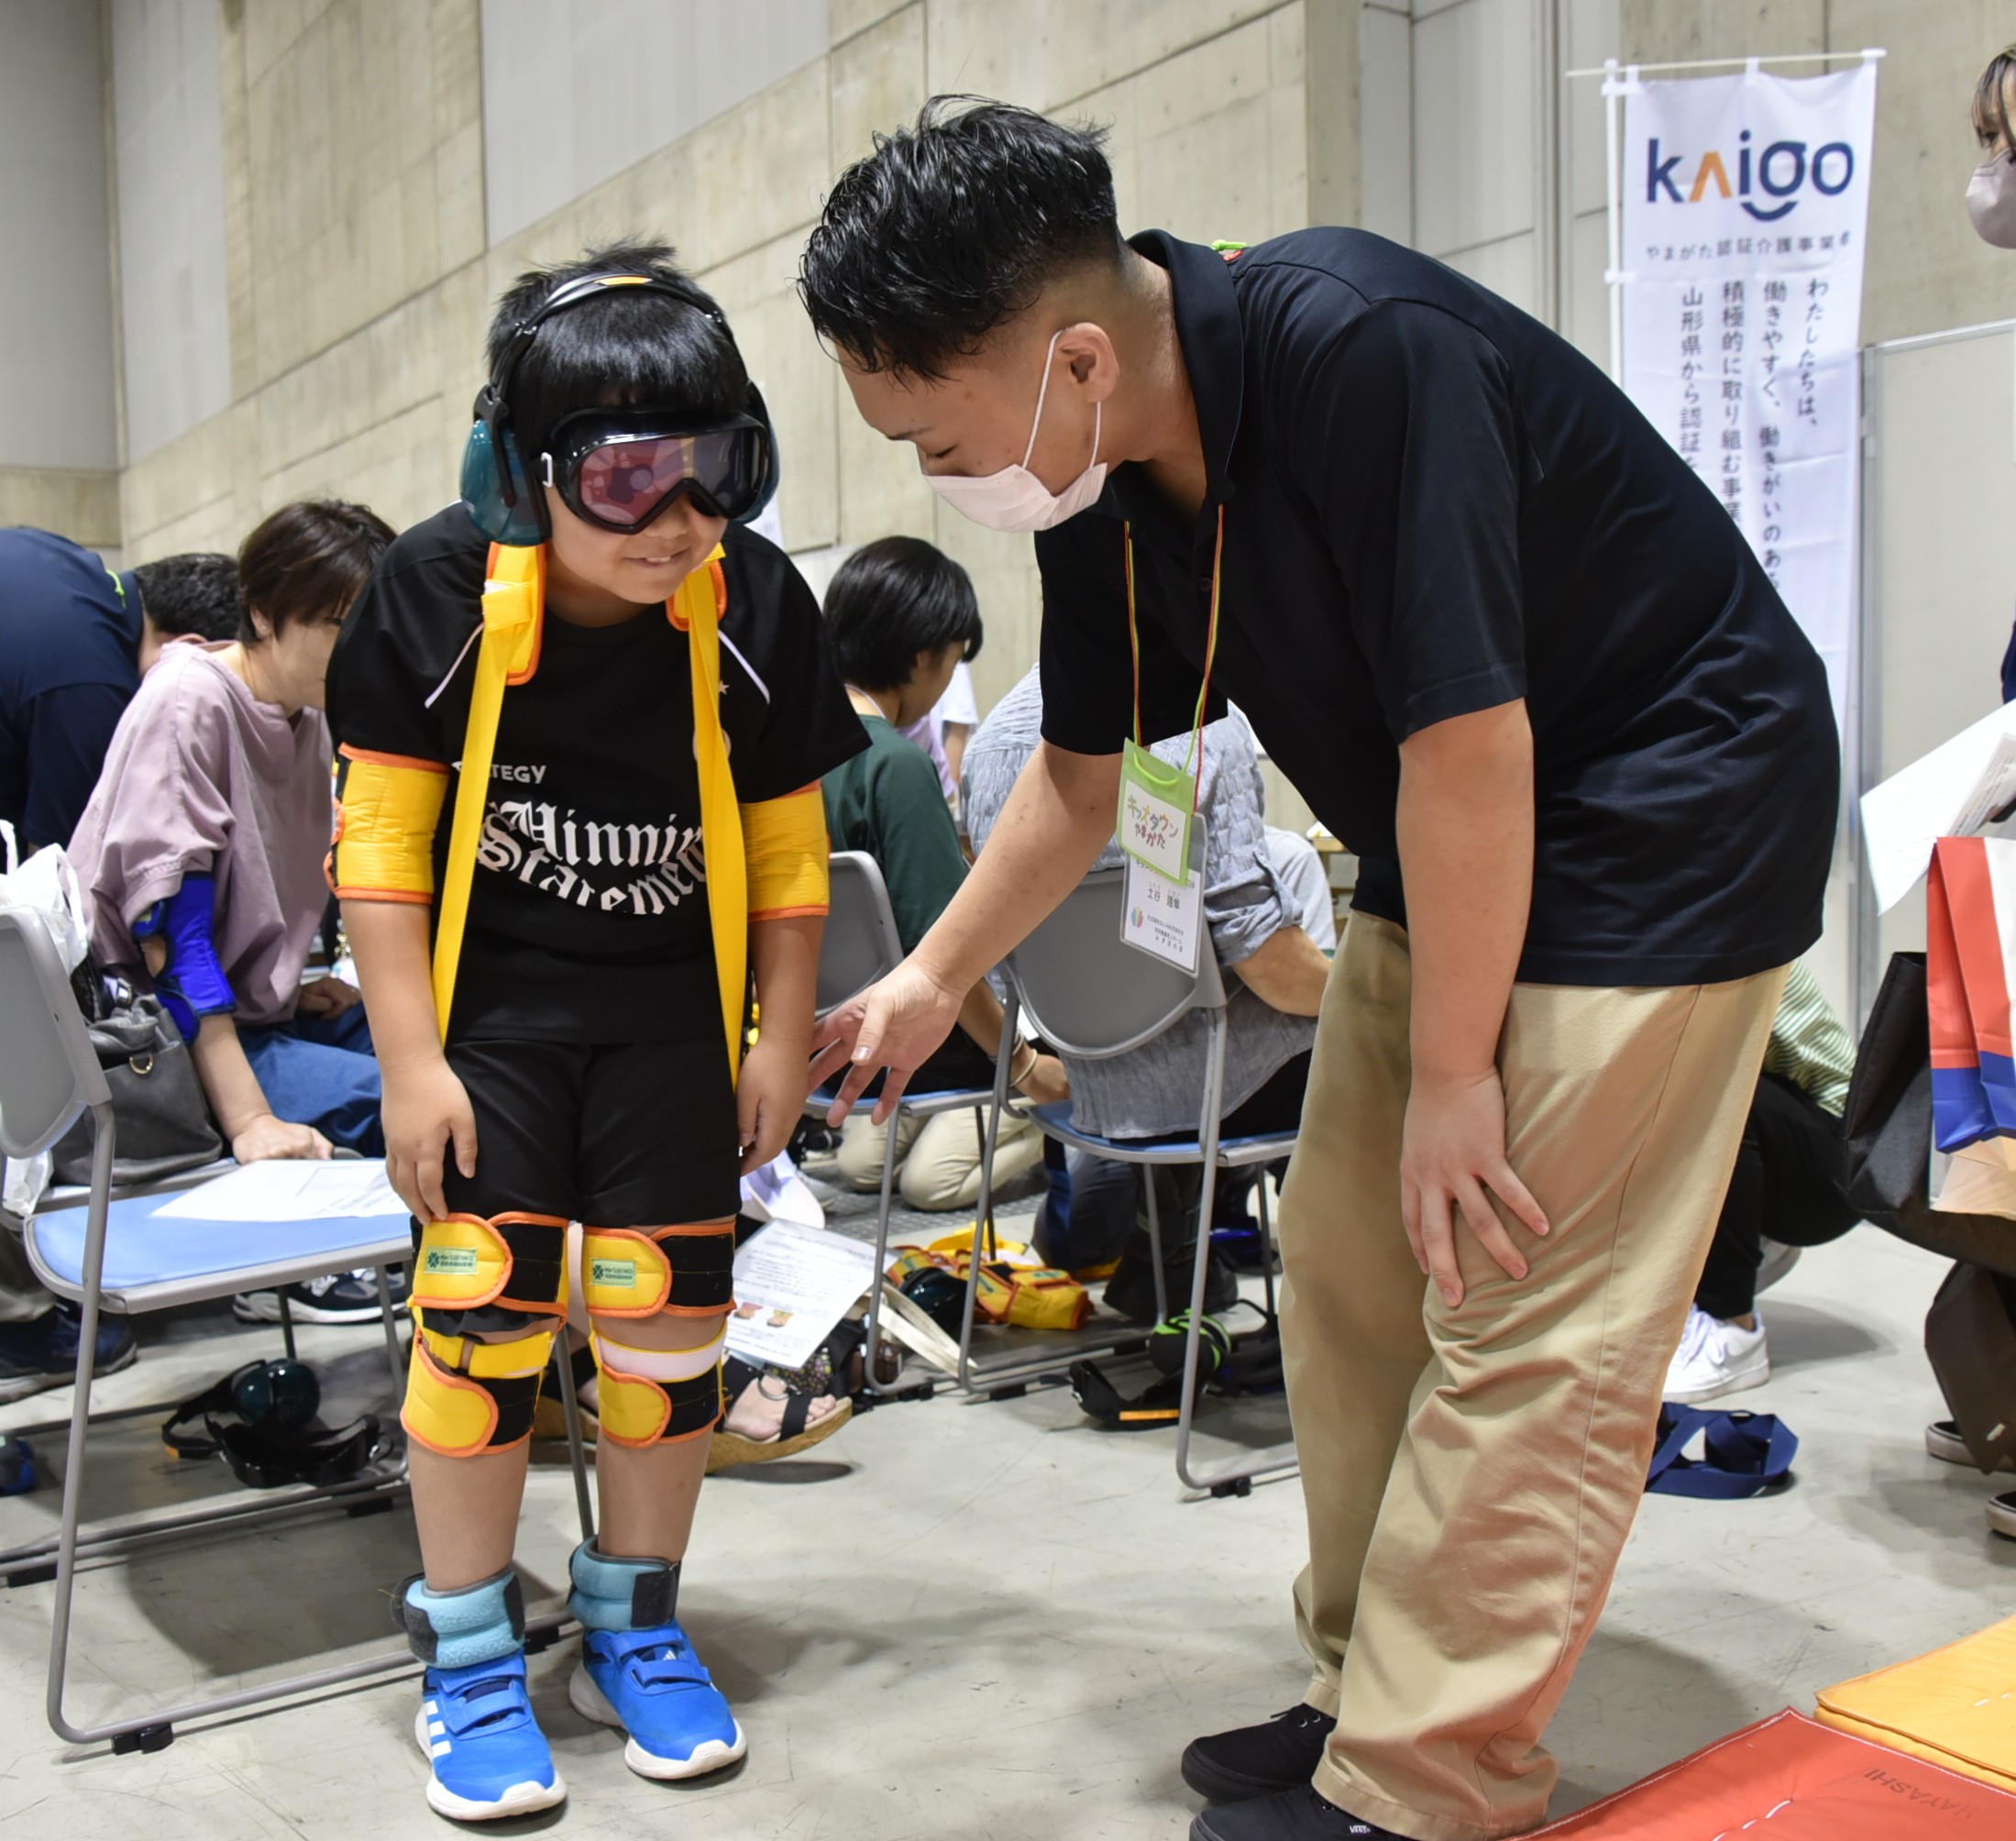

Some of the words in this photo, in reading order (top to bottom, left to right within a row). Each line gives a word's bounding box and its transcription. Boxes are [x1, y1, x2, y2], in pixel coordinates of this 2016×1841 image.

[1647, 129, 1854, 221] kaigo
[1647, 231, 1850, 261] やまがた認証介護事業者
[1797, 278, 1828, 425] わたしたちは、
[490, 764, 547, 785] TEGY
[500, 800, 704, 867] Winnin
[1127, 794, 1179, 838] キッズタウン
[477, 800, 707, 915] Statemen
[1863, 1768, 1981, 1820] HAYASHI
[1349, 1824, 1368, 1835] VANS
